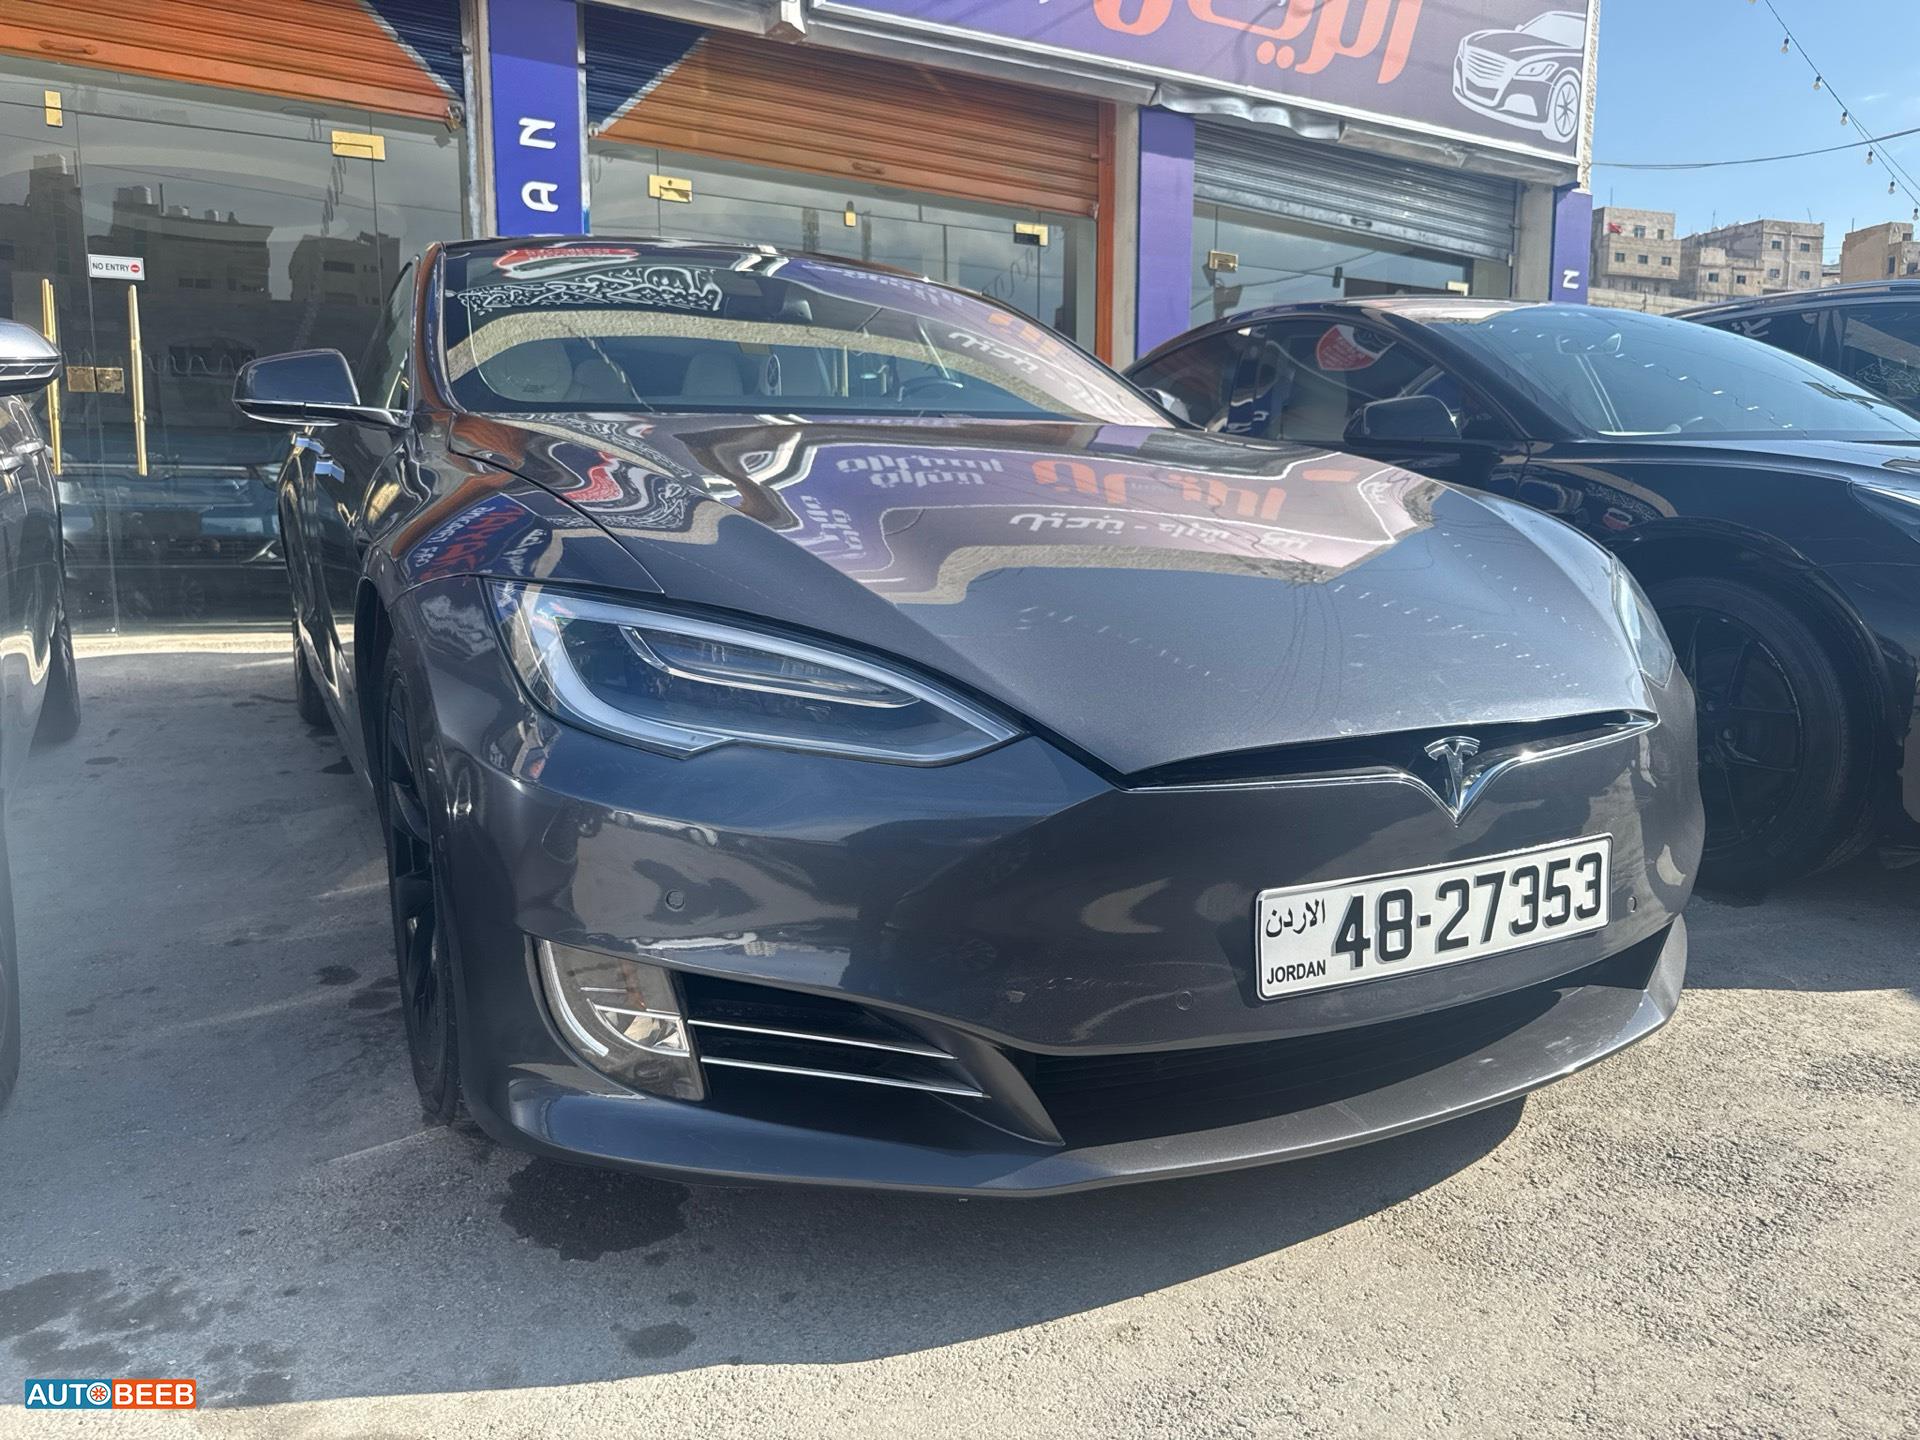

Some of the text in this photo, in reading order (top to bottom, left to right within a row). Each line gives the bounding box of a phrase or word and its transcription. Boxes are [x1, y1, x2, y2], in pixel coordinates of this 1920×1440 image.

[92, 262, 129, 272] NO ENTRY
[1333, 851, 1603, 969] 48-27353
[1266, 959, 1327, 985] JORDAN
